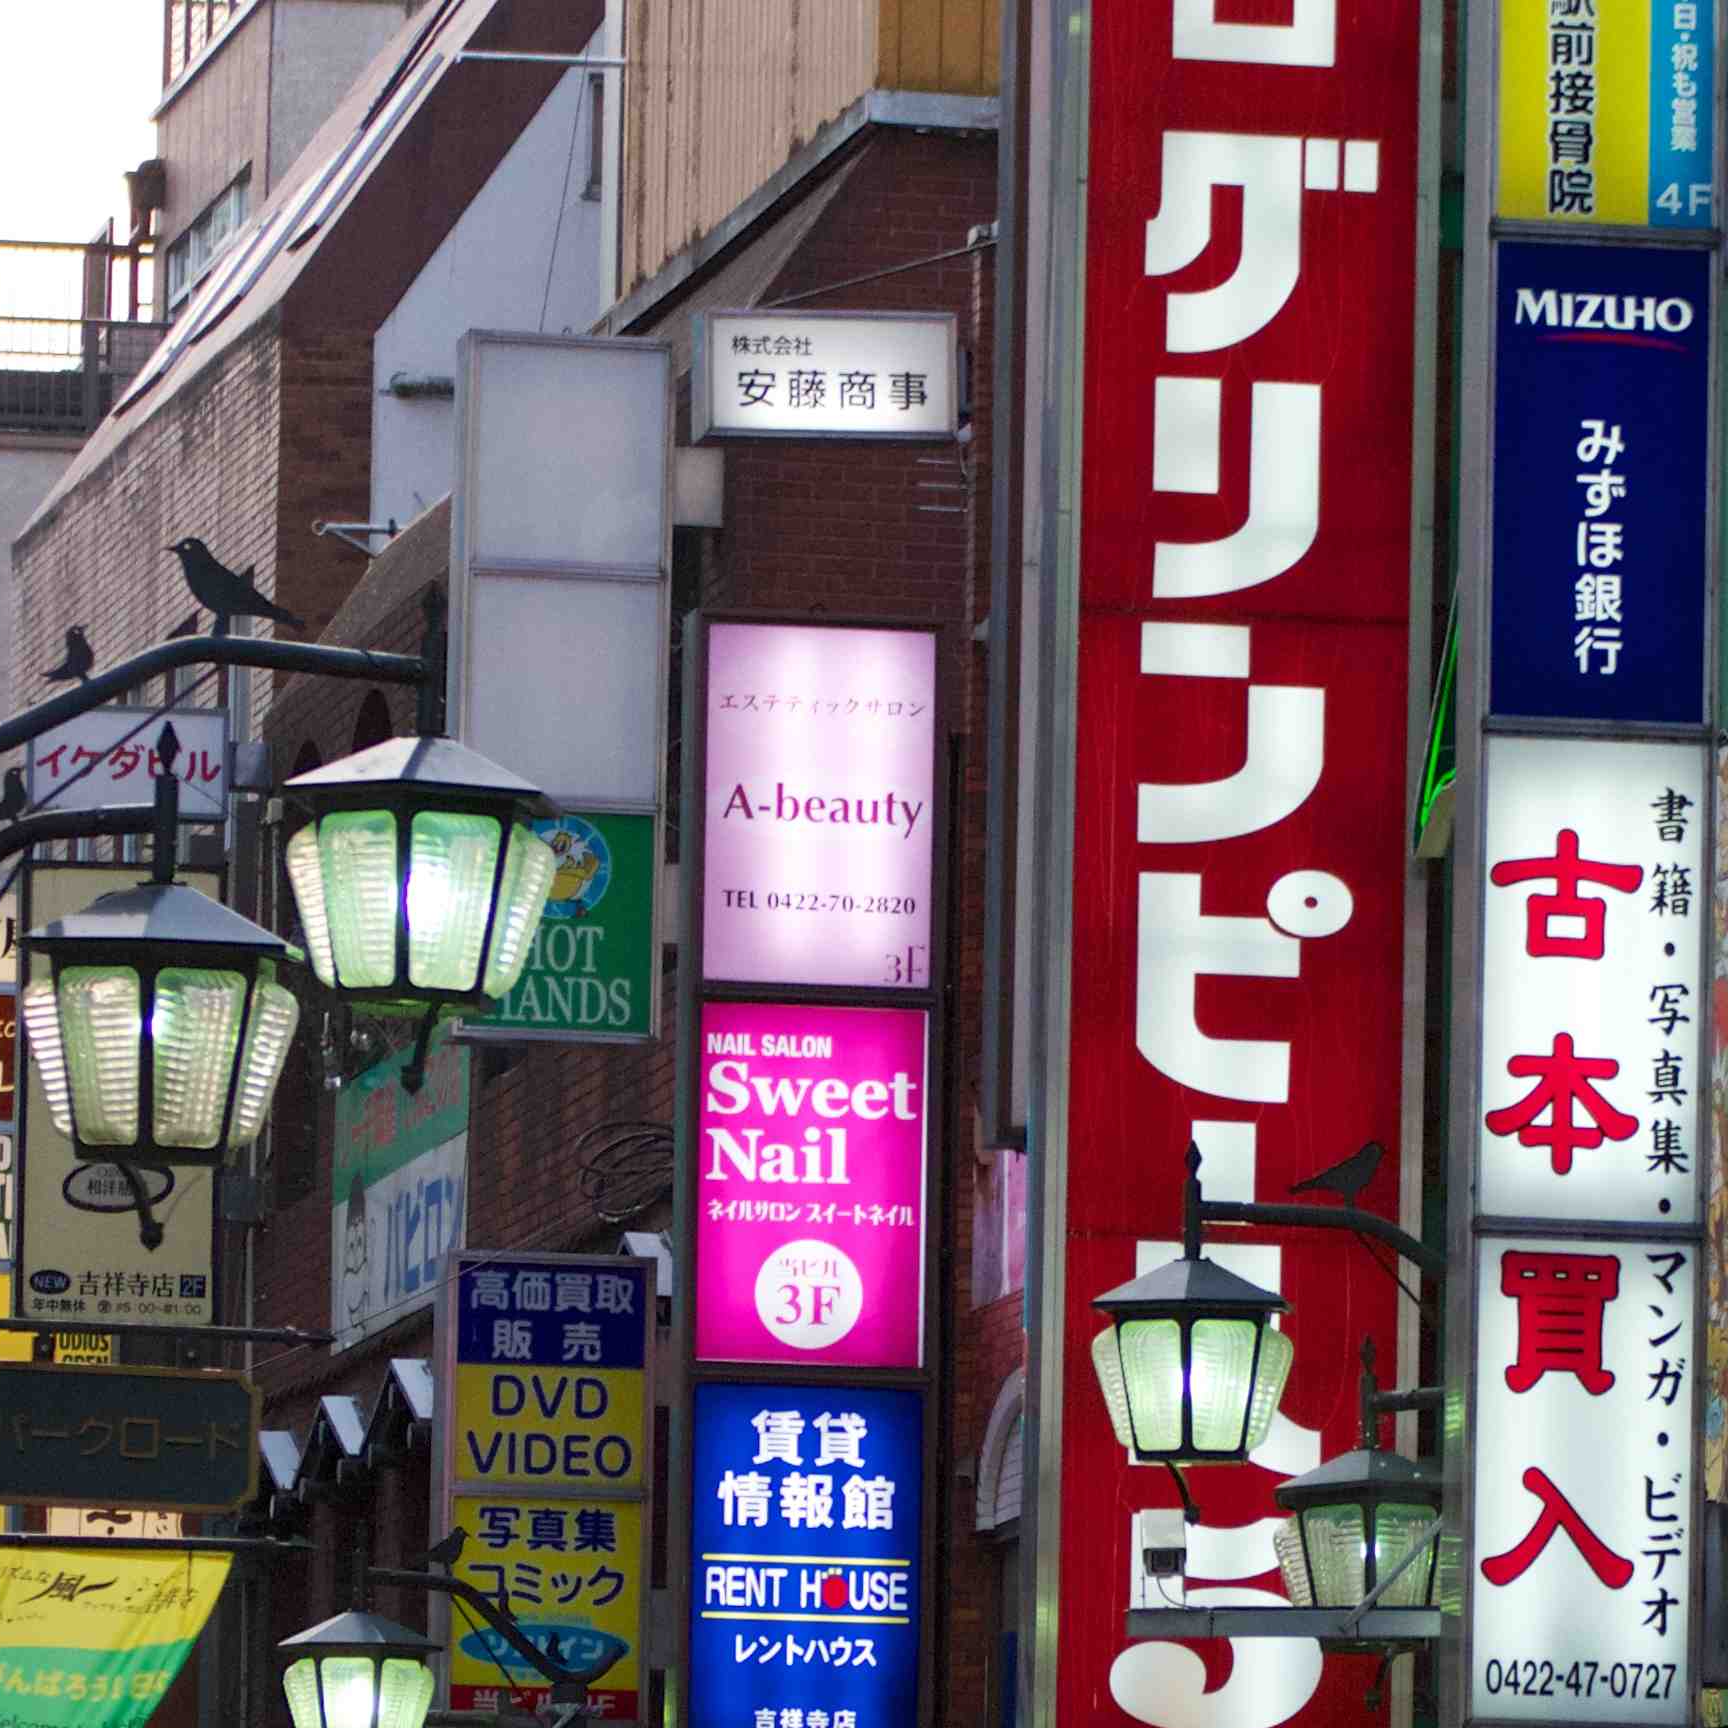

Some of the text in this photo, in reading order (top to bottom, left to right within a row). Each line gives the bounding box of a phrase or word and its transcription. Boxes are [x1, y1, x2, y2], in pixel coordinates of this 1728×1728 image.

[1655, 182, 1713, 214] 4F
[1514, 289, 1694, 333] MIZUHO
[731, 335, 814, 357] 株式会社
[736, 369, 928, 411] 安藤商事
[1573, 419, 1626, 676] みずほ銀行
[720, 693, 927, 718] エステティックサロン
[722, 782, 925, 839] A-beauty
[722, 888, 917, 916] TEL 0422-70-2820
[883, 945, 927, 986] 3F
[1485, 828, 1644, 1176] 古本
[706, 1031, 833, 1059] NAIL SALON
[705, 1060, 918, 1121] Sweet
[704, 1128, 852, 1185] Nail
[706, 1198, 915, 1228] ネイルサロン スイートネイル
[34, 1272, 207, 1298] NEW 吉祥寺店 2F
[775, 1256, 839, 1277] 当ビル
[471, 1270, 636, 1316] 高価買取
[774, 1284, 841, 1326] 3F
[491, 1318, 603, 1362] 販売
[490, 1374, 609, 1421] DVD
[750, 1409, 868, 1469] 賃貸
[1480, 1250, 1635, 1590] 買入
[466, 1430, 633, 1480] VIDEO
[1640, 1250, 1689, 1637] マンガ・ビデオ
[717, 1470, 897, 1531] 情報館
[477, 1506, 617, 1554] 写真集
[467, 1561, 626, 1606] コミック
[704, 1566, 788, 1606] RENT
[733, 1633, 878, 1668] レントハウス
[1485, 1659, 1678, 1701] 0422-47-0727
